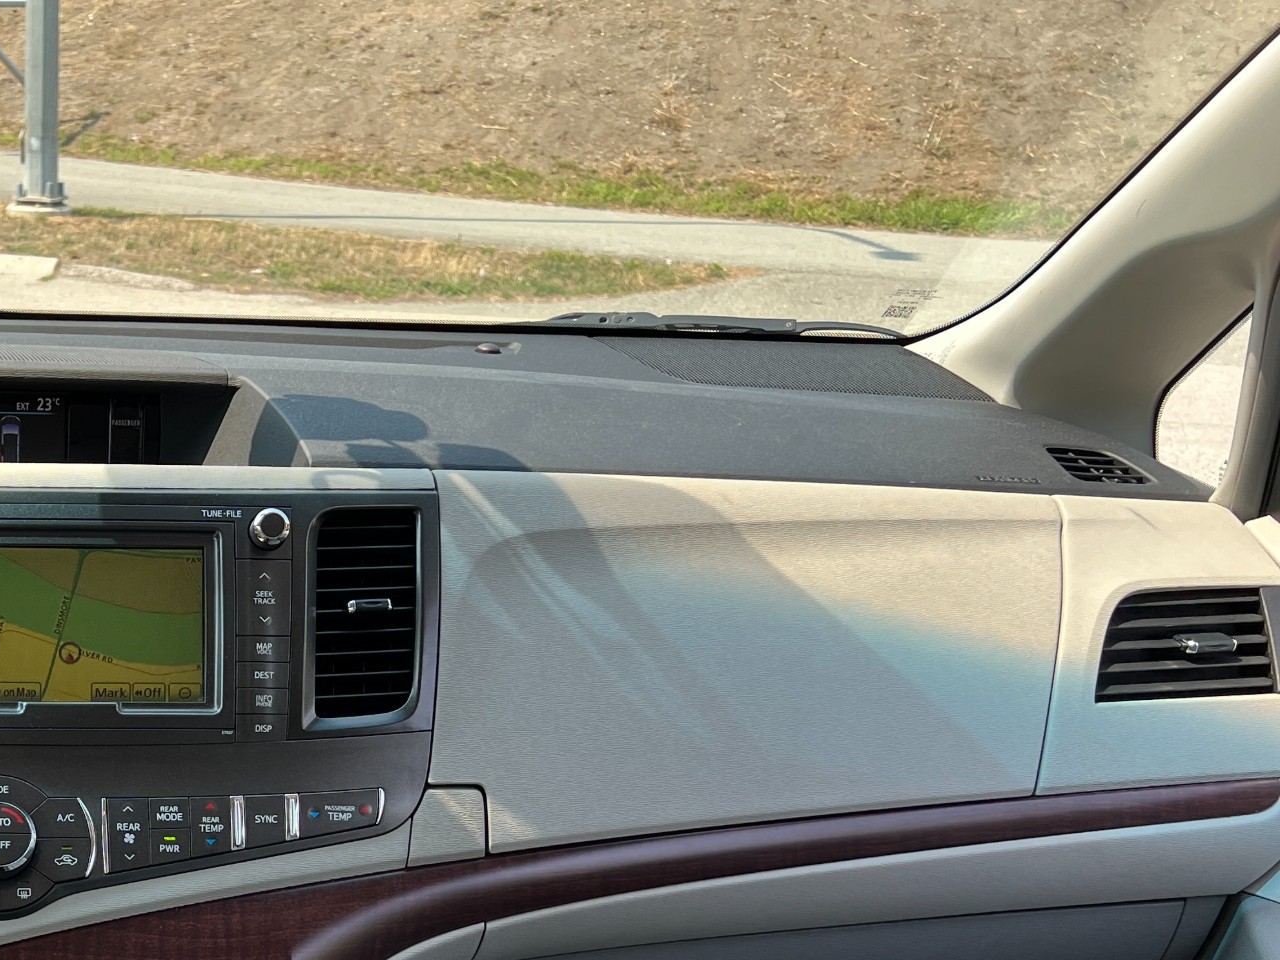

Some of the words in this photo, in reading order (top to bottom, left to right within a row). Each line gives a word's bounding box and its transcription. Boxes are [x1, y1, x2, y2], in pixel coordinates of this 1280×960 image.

[16, 402, 29, 411] EXT
[255, 590, 273, 598] SEEK
[253, 597, 276, 605] TRACK
[256, 643, 273, 651] MAP
[254, 671, 275, 680] DEST
[3, 690, 16, 698] on
[16, 687, 37, 699] Map
[95, 687, 126, 699] Mark
[144, 687, 162, 698] Off
[255, 694, 273, 703] INFO
[254, 724, 273, 733] DISP
[160, 805, 179, 813] REAR
[56, 813, 75, 822] A/C
[156, 813, 183, 822] MODE
[202, 816, 219, 824] REAR
[255, 815, 278, 824] SYNC
[328, 812, 352, 821] TEMP
[117, 823, 141, 832] REAR
[199, 824, 224, 833] TEMP
[159, 844, 180, 853] PWR
